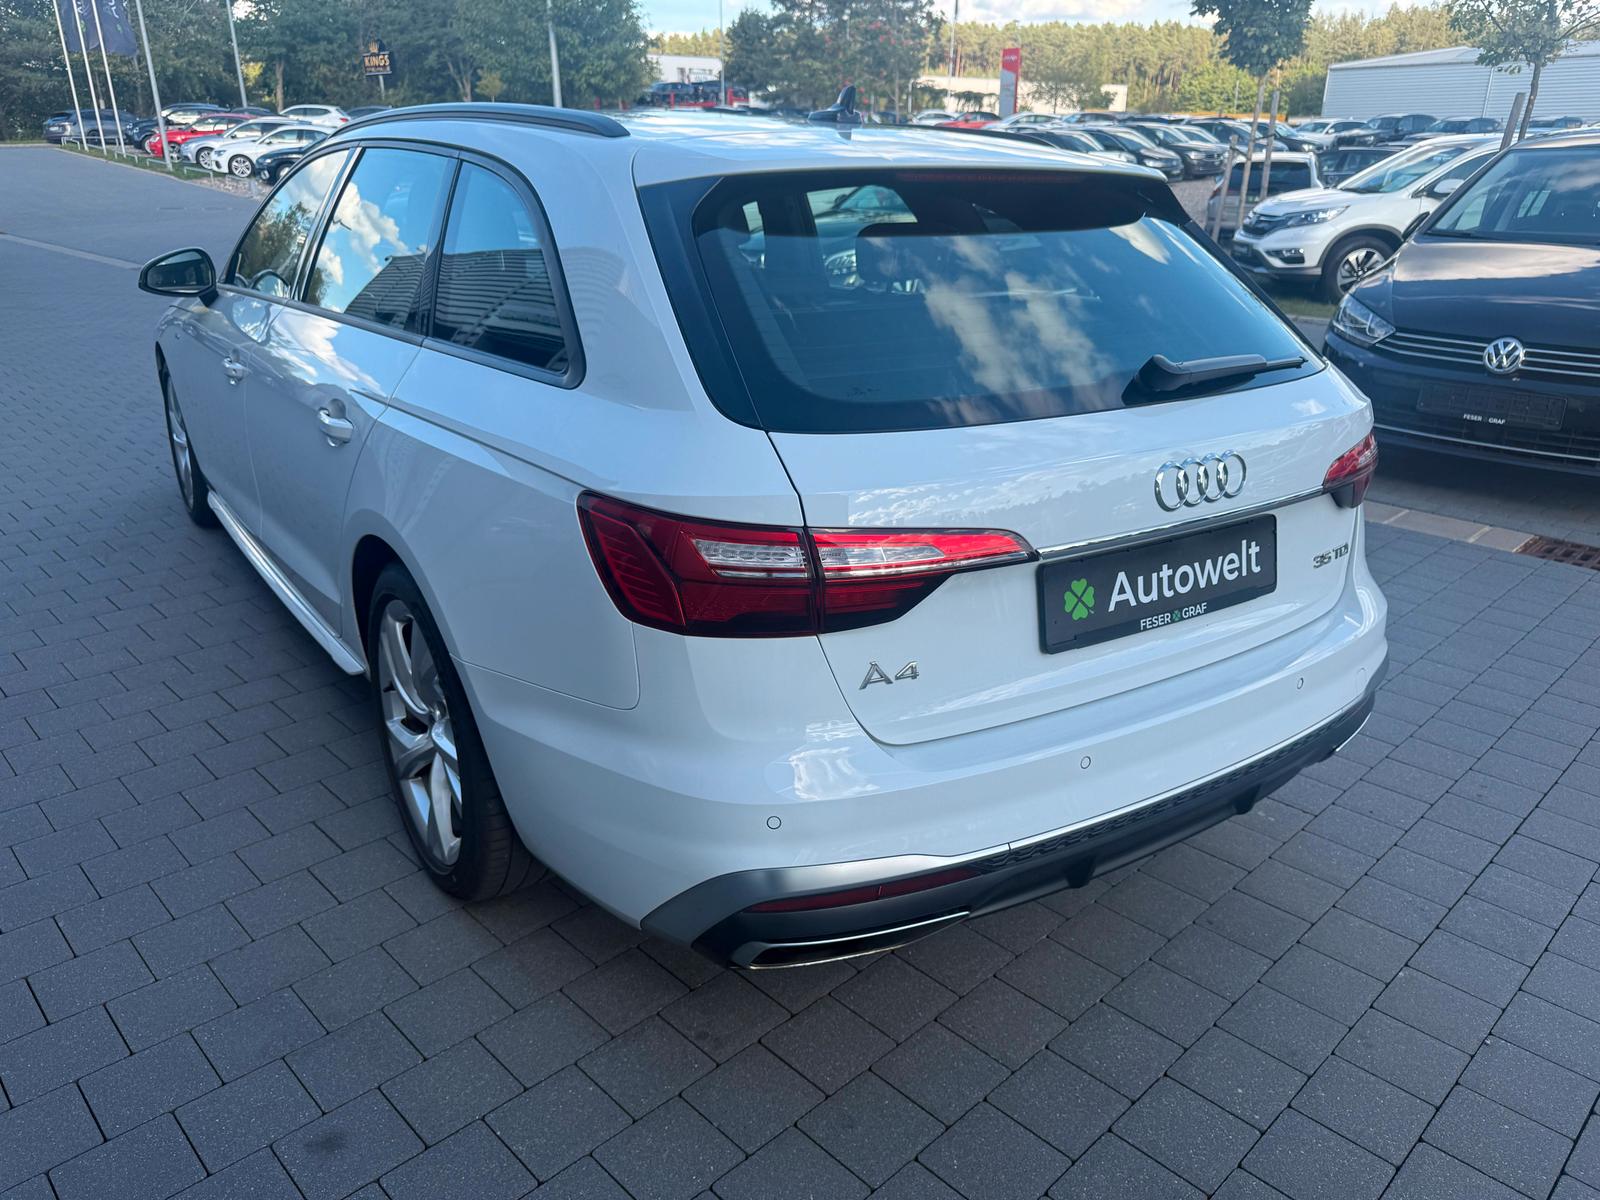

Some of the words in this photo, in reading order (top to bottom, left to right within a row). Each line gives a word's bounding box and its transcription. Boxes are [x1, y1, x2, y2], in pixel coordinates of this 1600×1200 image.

[364, 54, 390, 67] KINGS
[1463, 413, 1482, 422] FESER
[1488, 417, 1506, 425] GRAF
[1313, 551, 1331, 569] 35
[1108, 539, 1262, 613] Autowelt
[1140, 612, 1171, 631] FESER
[1182, 602, 1207, 619] GRAF
[859, 661, 920, 690] A4
